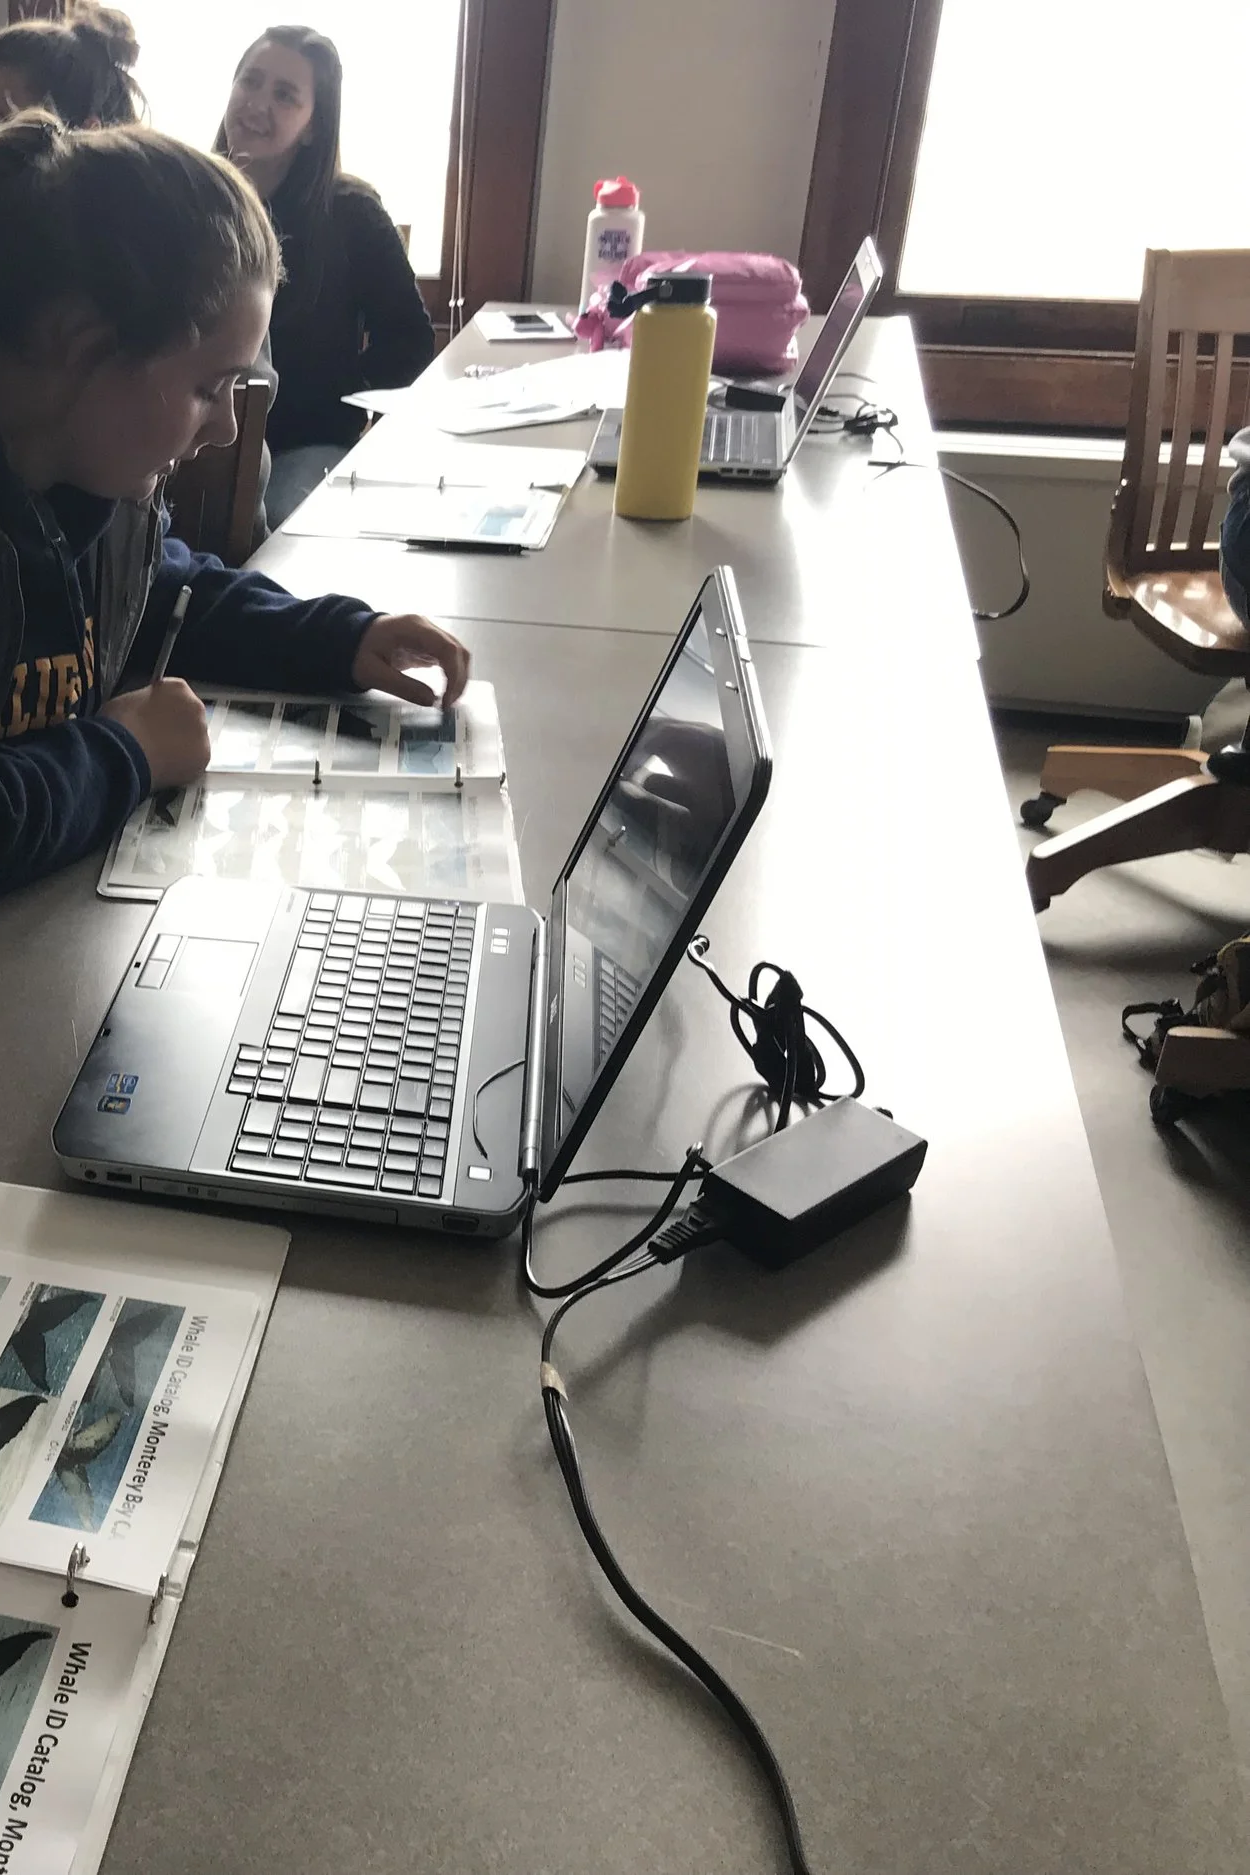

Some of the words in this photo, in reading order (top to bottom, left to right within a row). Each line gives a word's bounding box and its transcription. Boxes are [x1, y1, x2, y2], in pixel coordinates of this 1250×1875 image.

[181, 1315, 209, 1353] Whale
[175, 1354, 194, 1369] ID
[152, 1369, 188, 1417] Catalog,
[125, 1420, 169, 1492] Monterey
[115, 1493, 144, 1518] Bay
[53, 1641, 92, 1704] Whale
[45, 1709, 69, 1730] ID
[8, 1733, 59, 1811] Catalog,
